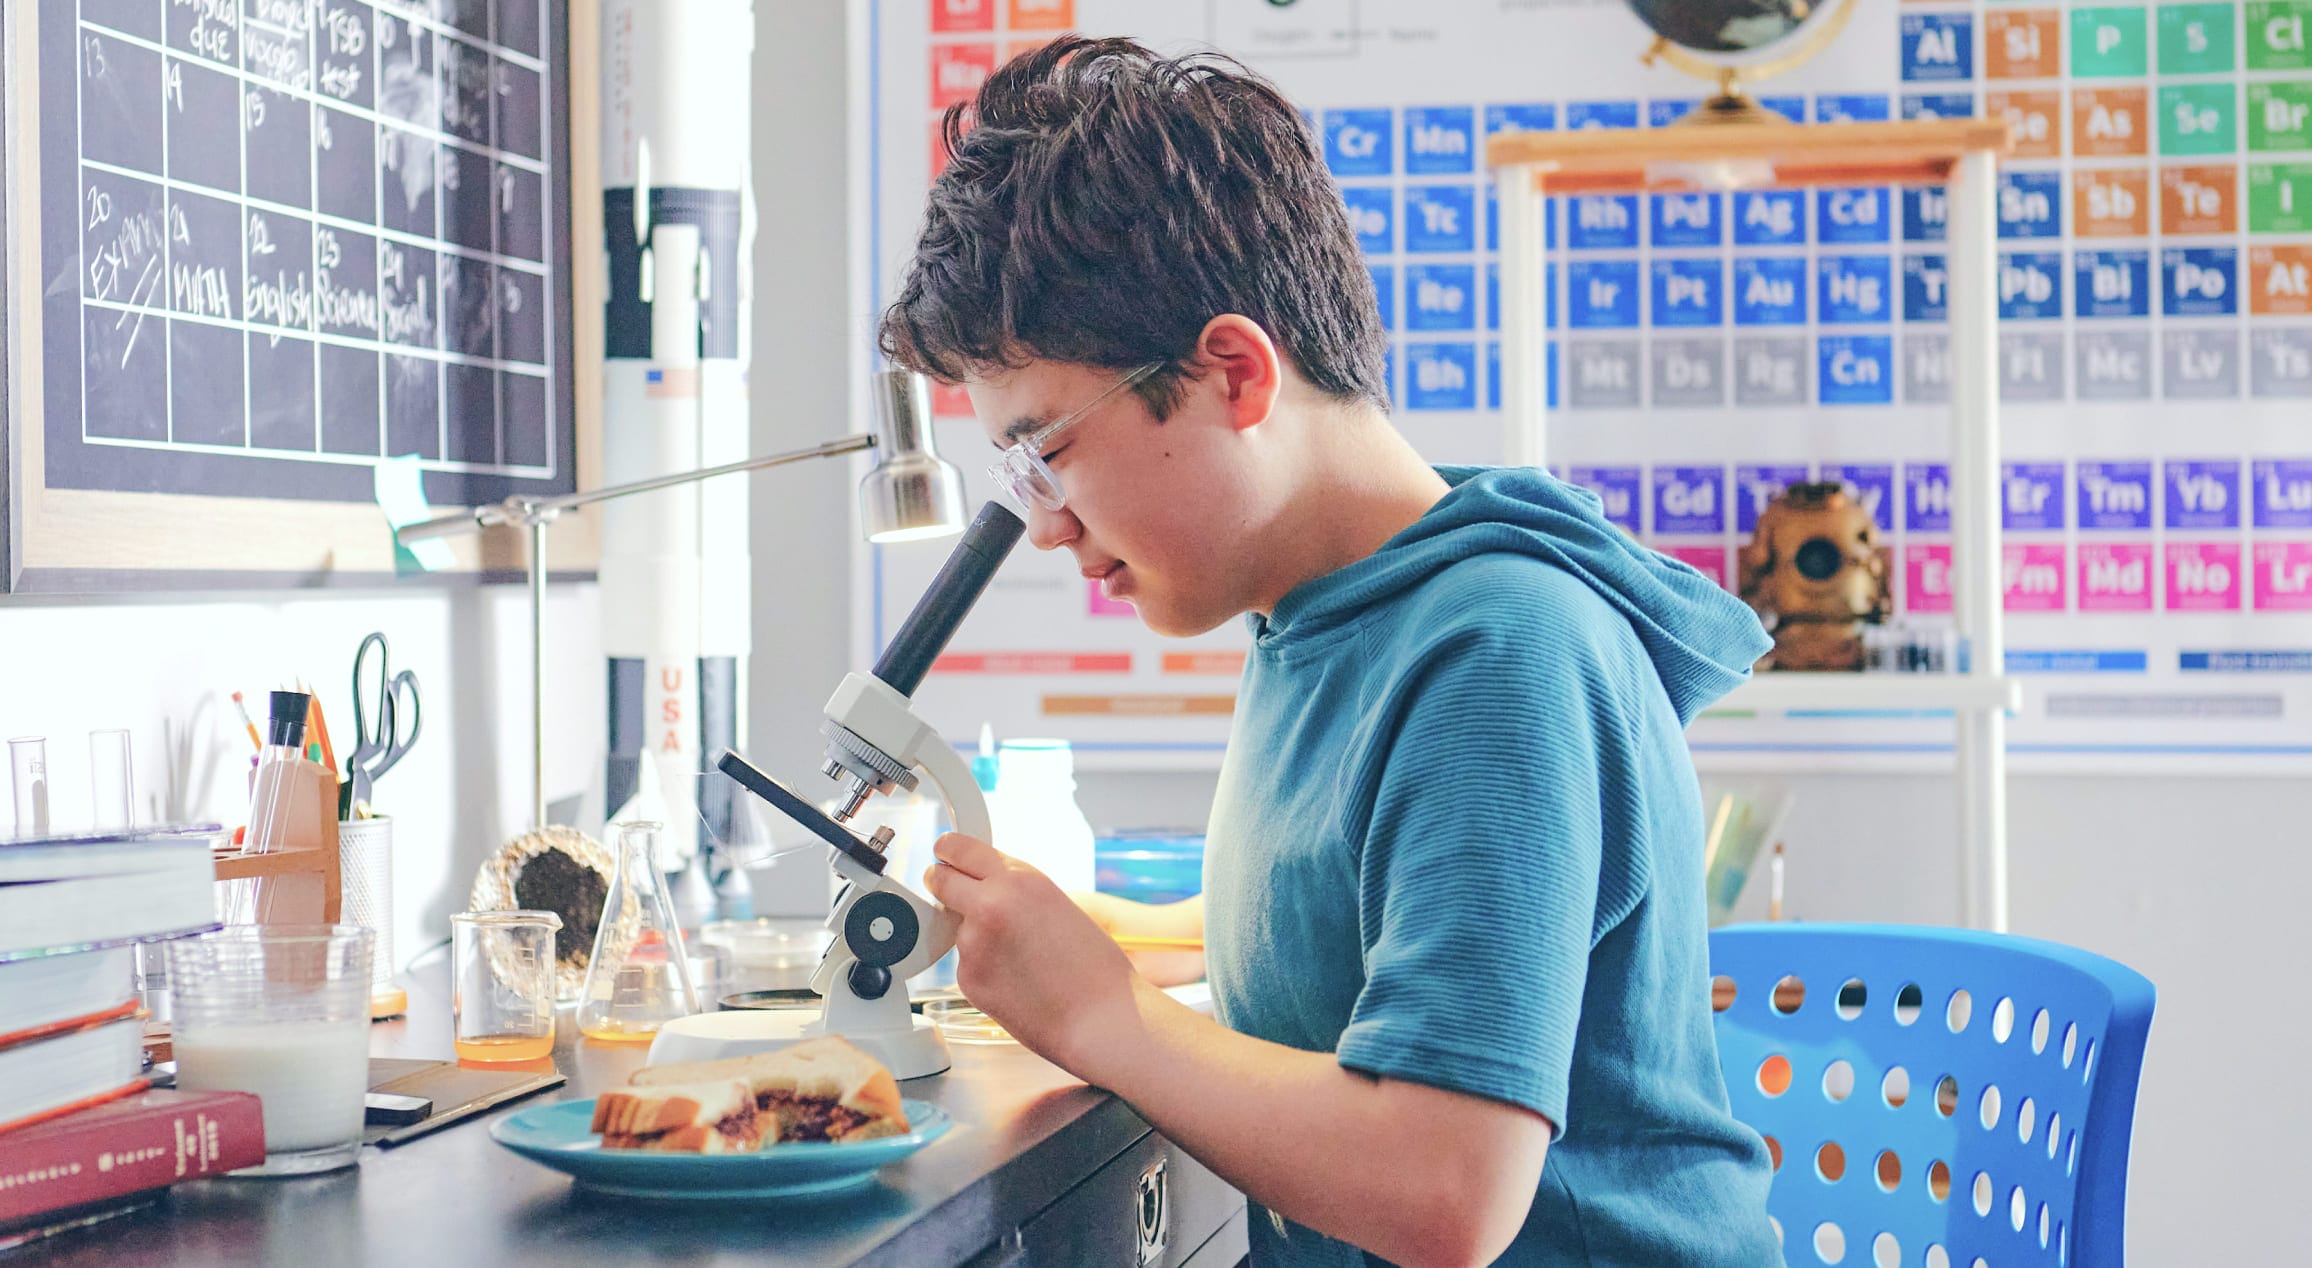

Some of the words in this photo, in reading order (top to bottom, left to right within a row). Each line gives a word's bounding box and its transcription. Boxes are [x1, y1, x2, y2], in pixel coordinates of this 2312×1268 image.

[1916, 26, 1958, 64] Al
[2005, 25, 2040, 60] Si
[2096, 25, 2121, 55] P
[2186, 22, 2208, 53] S
[2266, 15, 2304, 51] Cl
[85, 36, 106, 78] 13
[2087, 105, 2132, 139] As
[2175, 103, 2220, 134] Se
[2264, 98, 2310, 131] Br
[1338, 126, 1379, 158] Cr
[1413, 125, 1467, 154] Mn
[87, 185, 110, 232] 20
[1663, 194, 1710, 228] Pd
[1829, 190, 1878, 225] Cd
[2001, 187, 2049, 222] Sn
[2087, 184, 2136, 219] Sb
[2180, 182, 2221, 217] Te
[2280, 180, 2292, 212] I
[1421, 202, 1458, 234] Tc
[1745, 194, 1794, 235] Ag
[173, 261, 232, 320] MATH
[1666, 275, 1707, 307] Pt
[1745, 274, 1794, 306] Au
[1829, 272, 1880, 314] Hg
[2001, 266, 2052, 303] Pb
[2093, 263, 2132, 301] Bi
[2175, 264, 2226, 299] Po
[2268, 262, 2309, 297] At
[1666, 355, 1710, 388] Ds
[1831, 350, 1880, 385] Cn
[2088, 349, 2141, 382] Mc
[2180, 348, 2222, 381] Lv
[1663, 480, 1715, 516] Gd
[2007, 477, 2050, 514] Er
[2084, 475, 2146, 514] Tm
[2178, 475, 2228, 513] Yb
[2086, 558, 2145, 595] Md
[2176, 556, 2232, 594] No
[661, 667, 683, 754] USA
